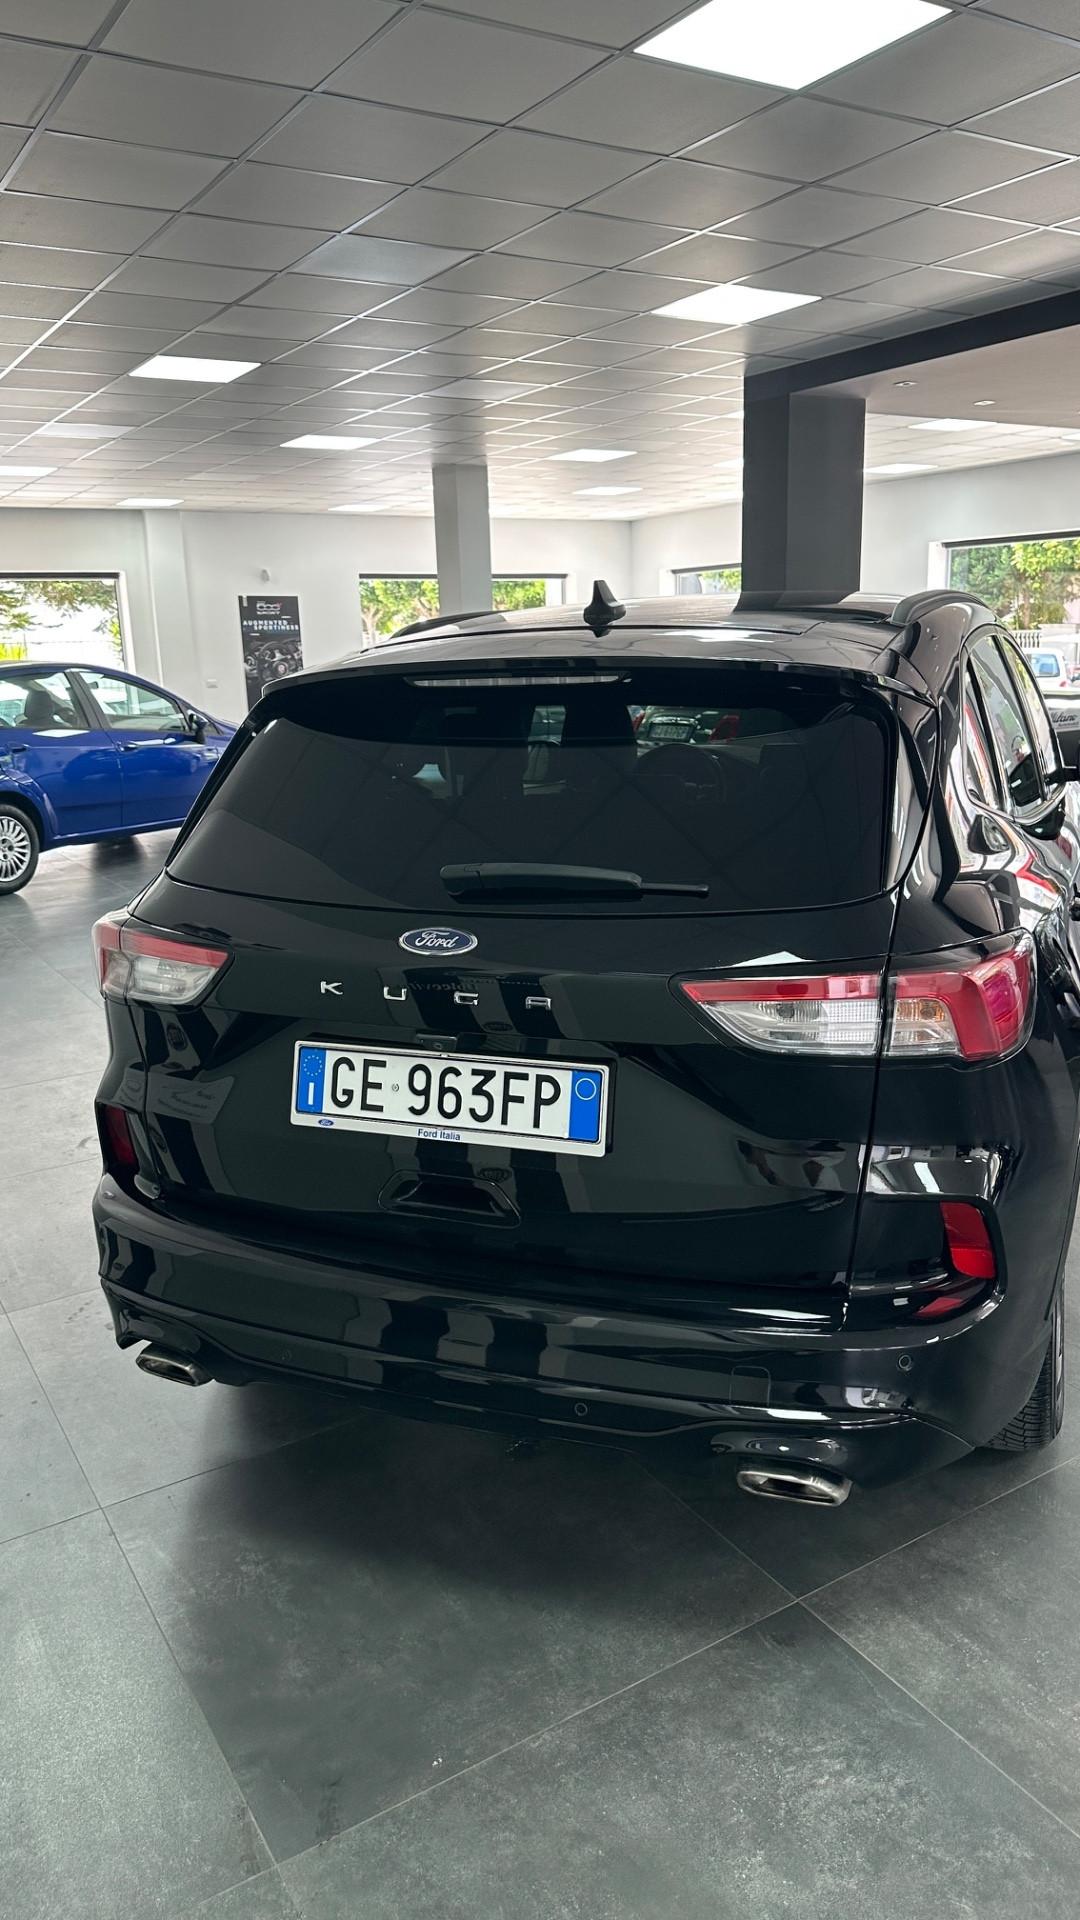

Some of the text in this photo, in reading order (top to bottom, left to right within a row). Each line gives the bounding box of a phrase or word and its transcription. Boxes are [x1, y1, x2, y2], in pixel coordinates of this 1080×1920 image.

[415, 930, 460, 948] Ford
[320, 981, 551, 1010] KUGA
[330, 1056, 562, 1129] GE 963FP
[418, 1128, 461, 1141] Ford Italia
